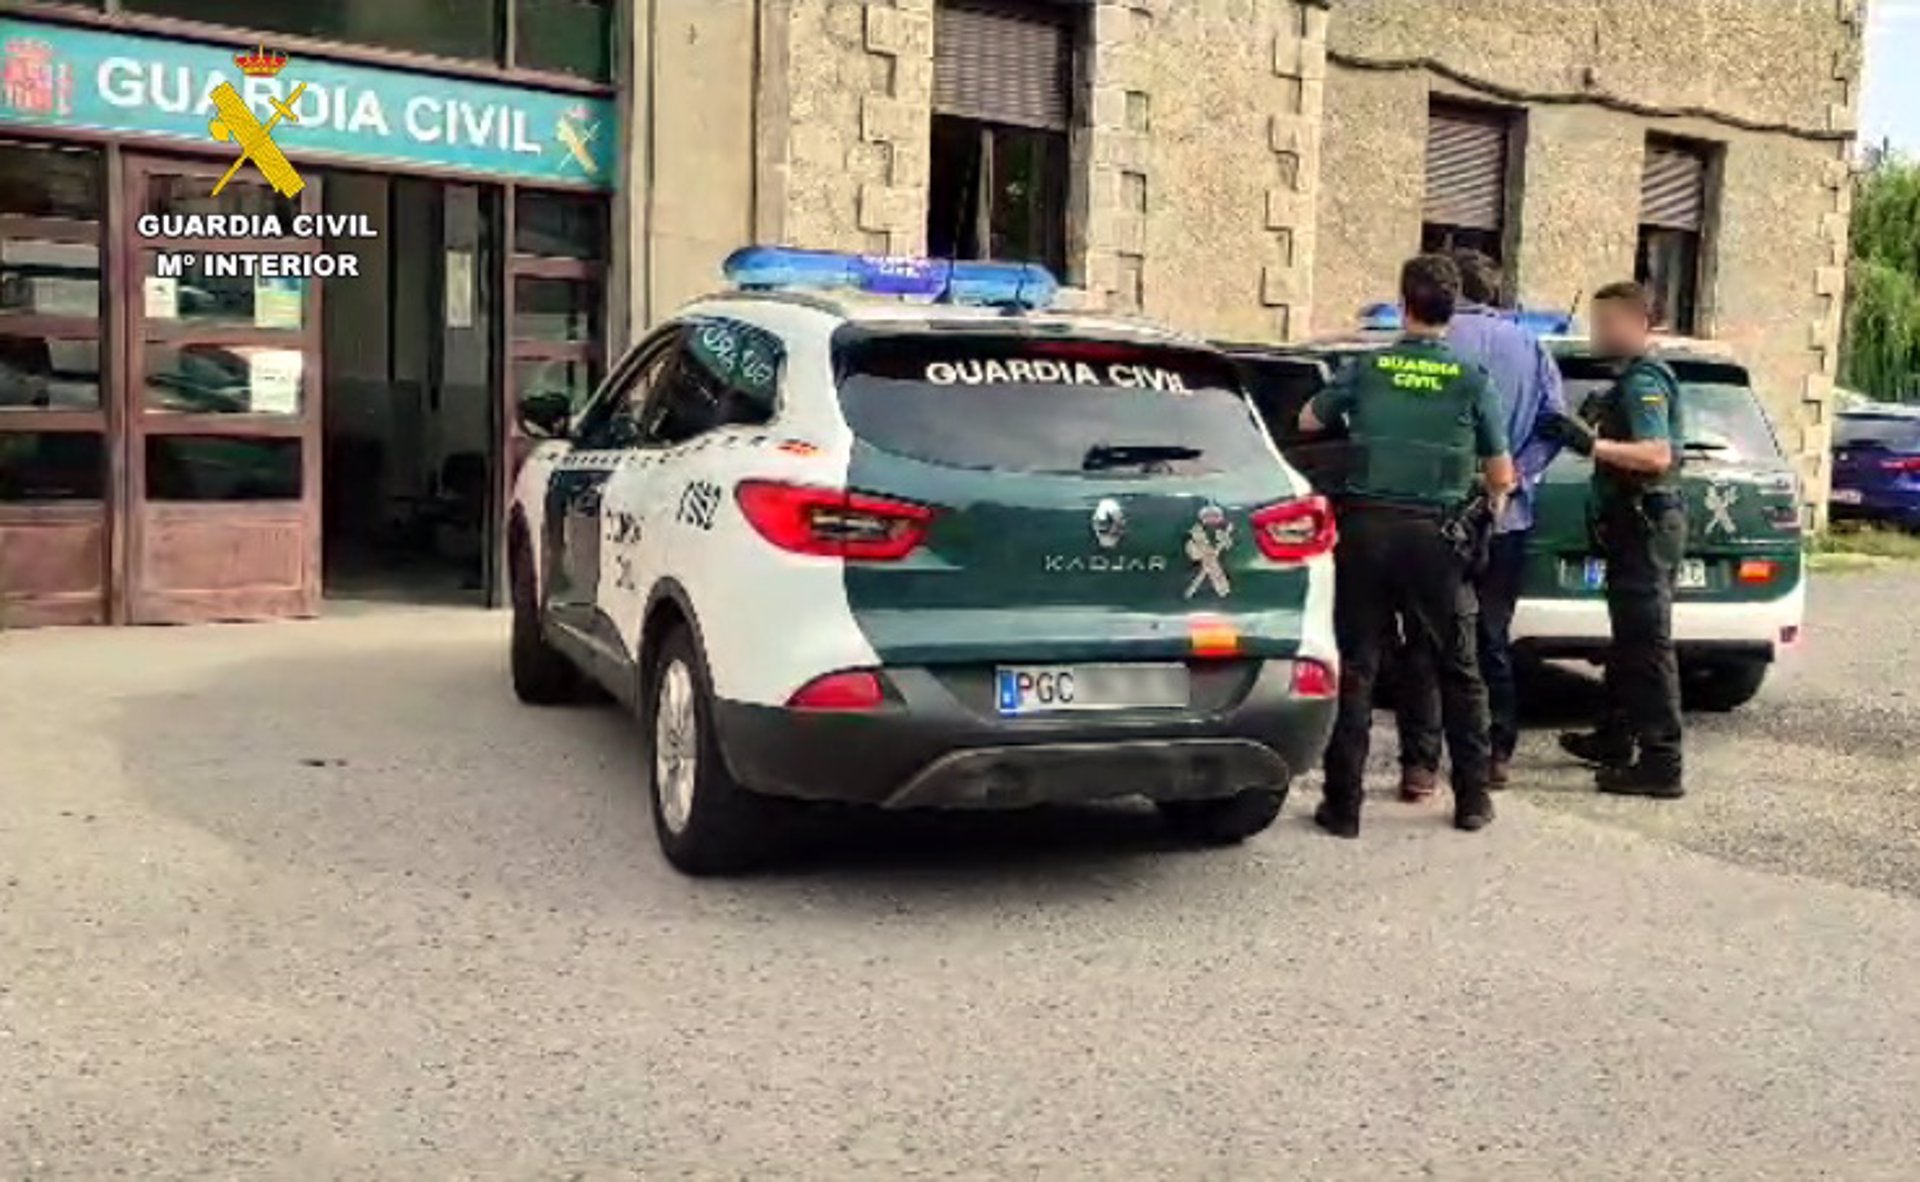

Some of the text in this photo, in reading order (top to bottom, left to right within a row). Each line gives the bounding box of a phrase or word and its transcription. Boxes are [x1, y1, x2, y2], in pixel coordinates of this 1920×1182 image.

[404, 95, 542, 154] CIVIL
[925, 358, 1194, 396] GUARDIA CIVIL
[1377, 355, 1459, 375] GUARDIA
[1393, 373, 1443, 391] CIVIL
[1044, 554, 1168, 571] KADJAR
[1016, 671, 1074, 704] PGC
